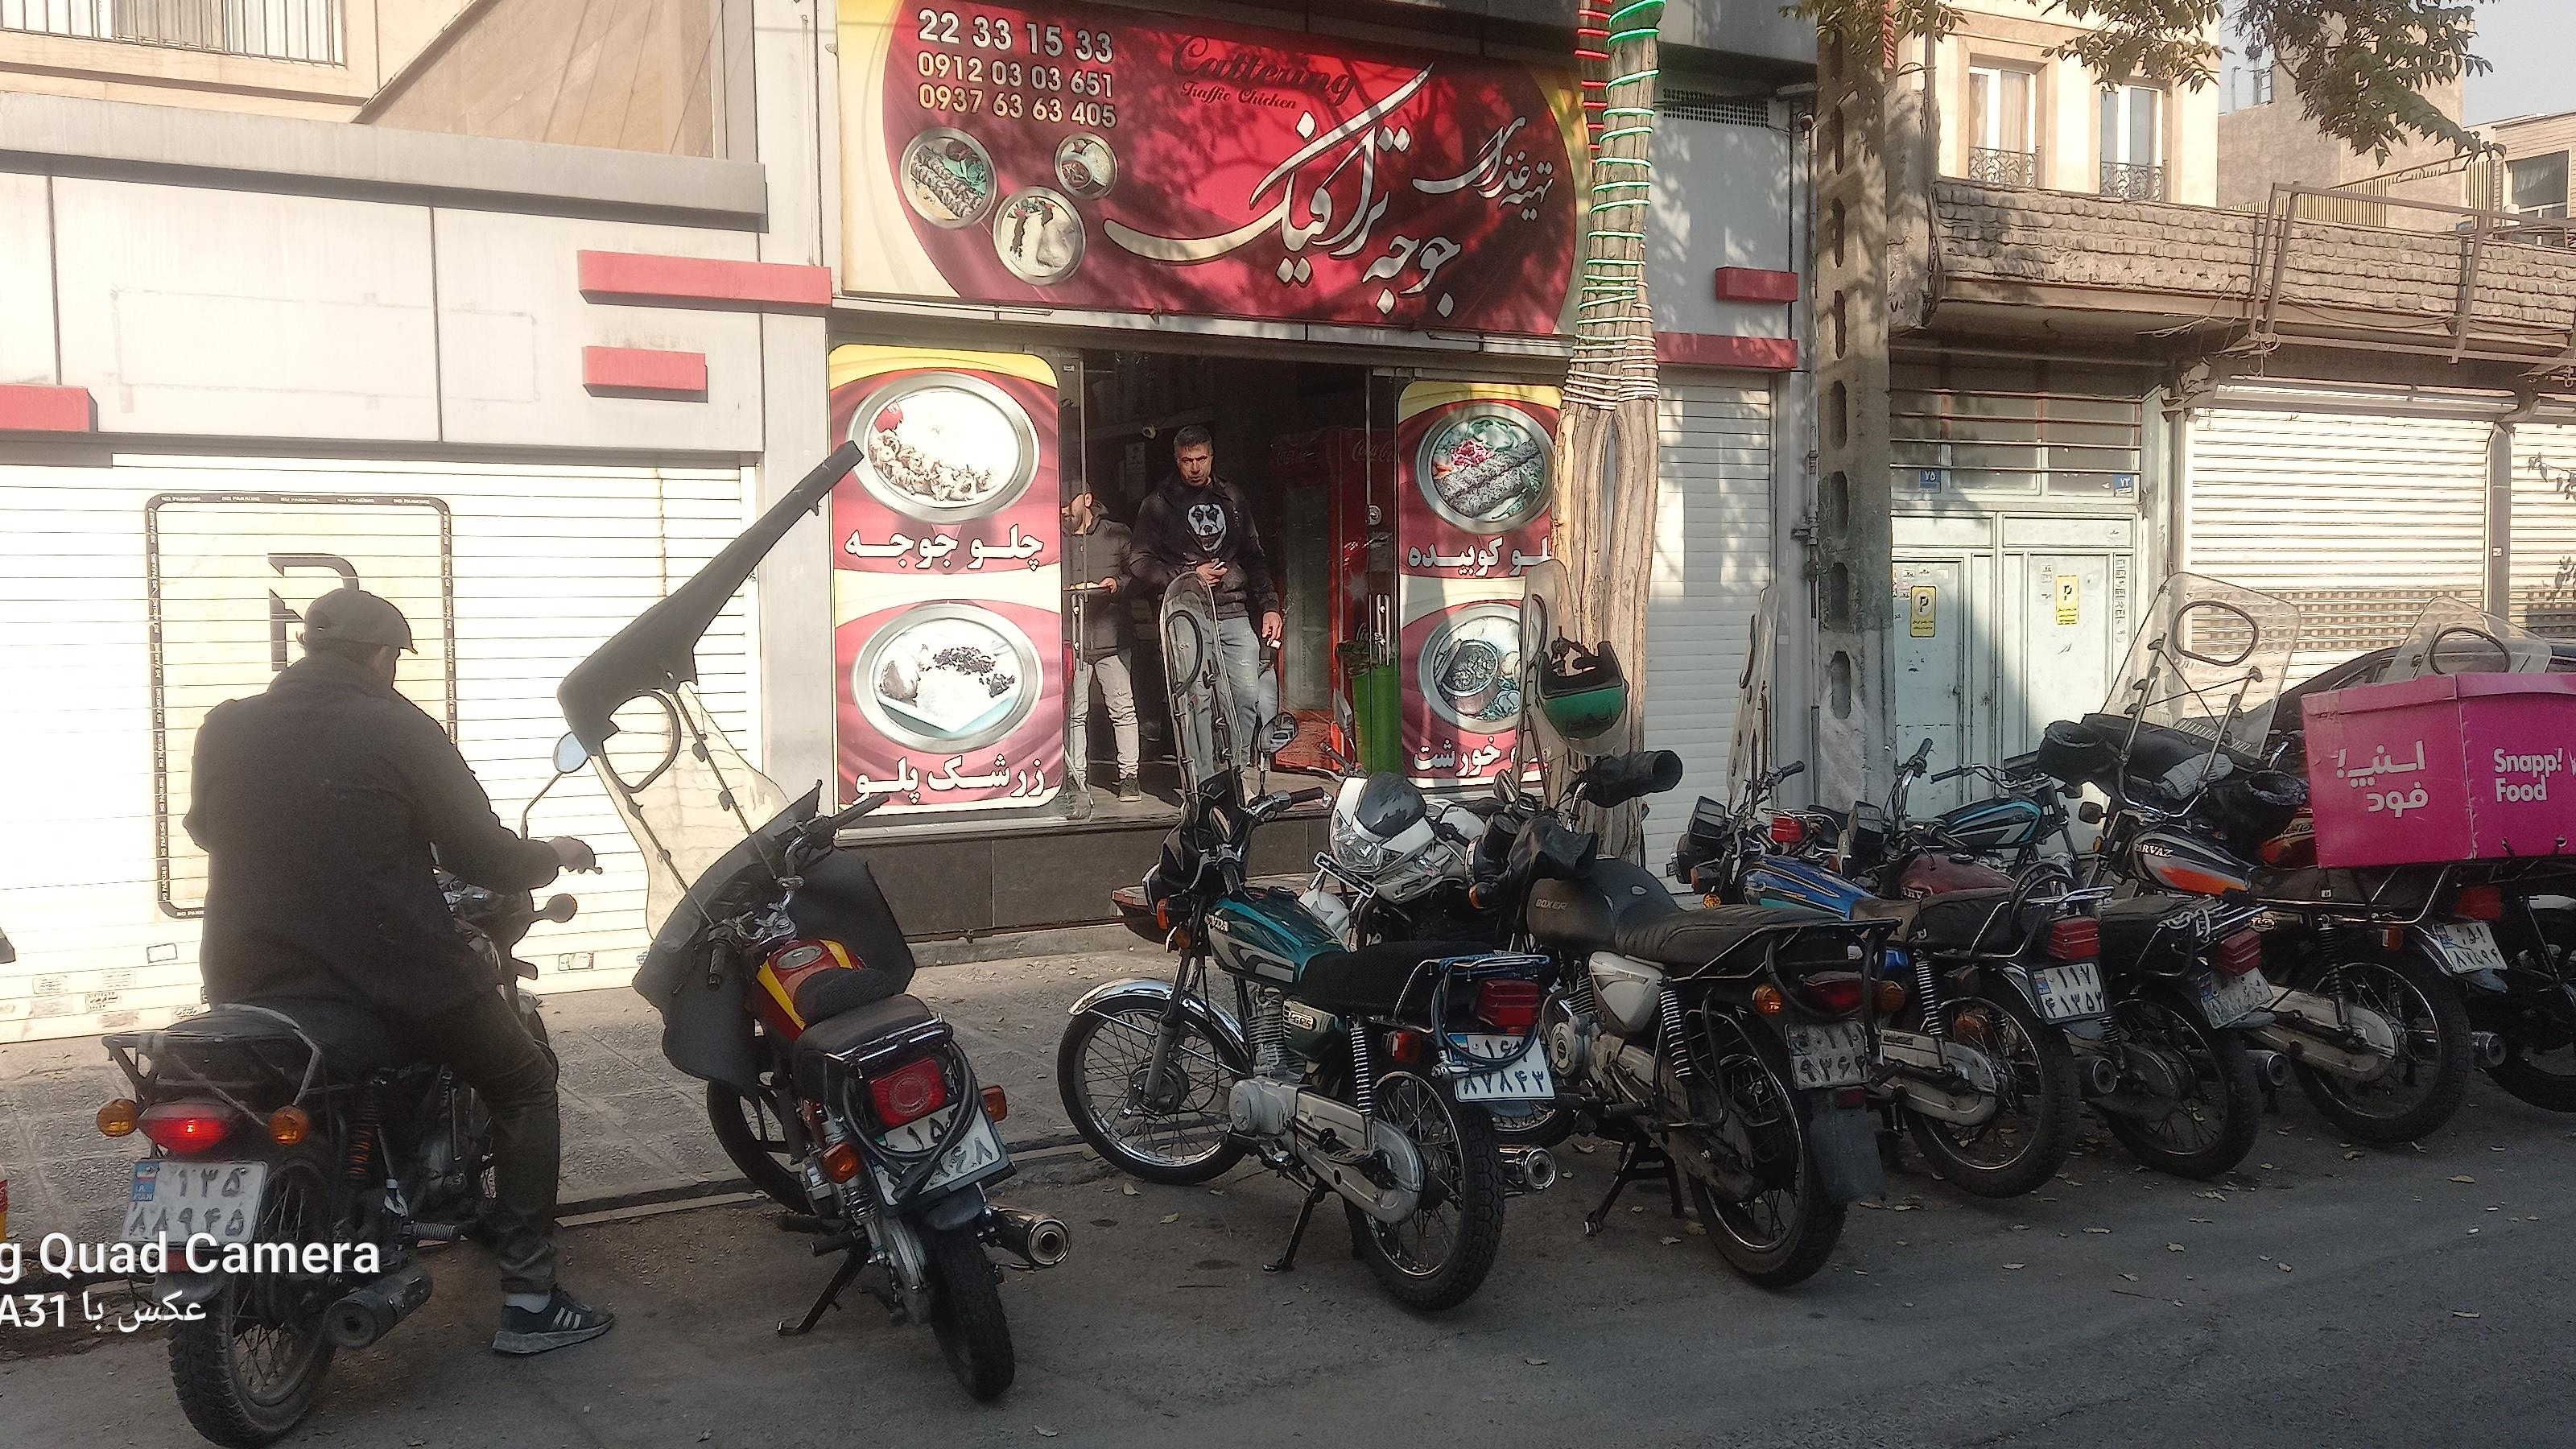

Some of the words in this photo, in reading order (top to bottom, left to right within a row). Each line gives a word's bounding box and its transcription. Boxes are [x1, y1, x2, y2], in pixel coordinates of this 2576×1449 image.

[918, 8, 960, 44] 22
[972, 14, 1012, 51] 33
[1026, 22, 1063, 56] 15
[1075, 29, 1113, 63] 33
[917, 51, 983, 83] 0912
[990, 60, 1022, 88] 03
[1030, 64, 1062, 91] 03
[1069, 69, 1112, 97] 651
[1180, 80, 1231, 104] Traffic
[1238, 89, 1296, 109] Chicken
[918, 82, 984, 114] 0937
[992, 92, 1024, 119] 63
[1031, 97, 1063, 123] 63
[1071, 101, 1117, 129] 405
[1103, 61, 1436, 286] ترافیک
[1499, 161, 1555, 221] تهیه
[1361, 232, 1461, 318] جوجه
[844, 529, 960, 570] جوجه
[967, 523, 1045, 572] چلو
[1407, 535, 1504, 577] کوبیده
[1509, 535, 1552, 577] لو
[927, 753, 1046, 798] زرشک
[1414, 735, 1502, 778] خورشت
[2493, 746, 2564, 778] Snapp!
[852, 756, 921, 805] پلو
[2365, 781, 2429, 818] فود
[2495, 775, 2548, 803] Food
